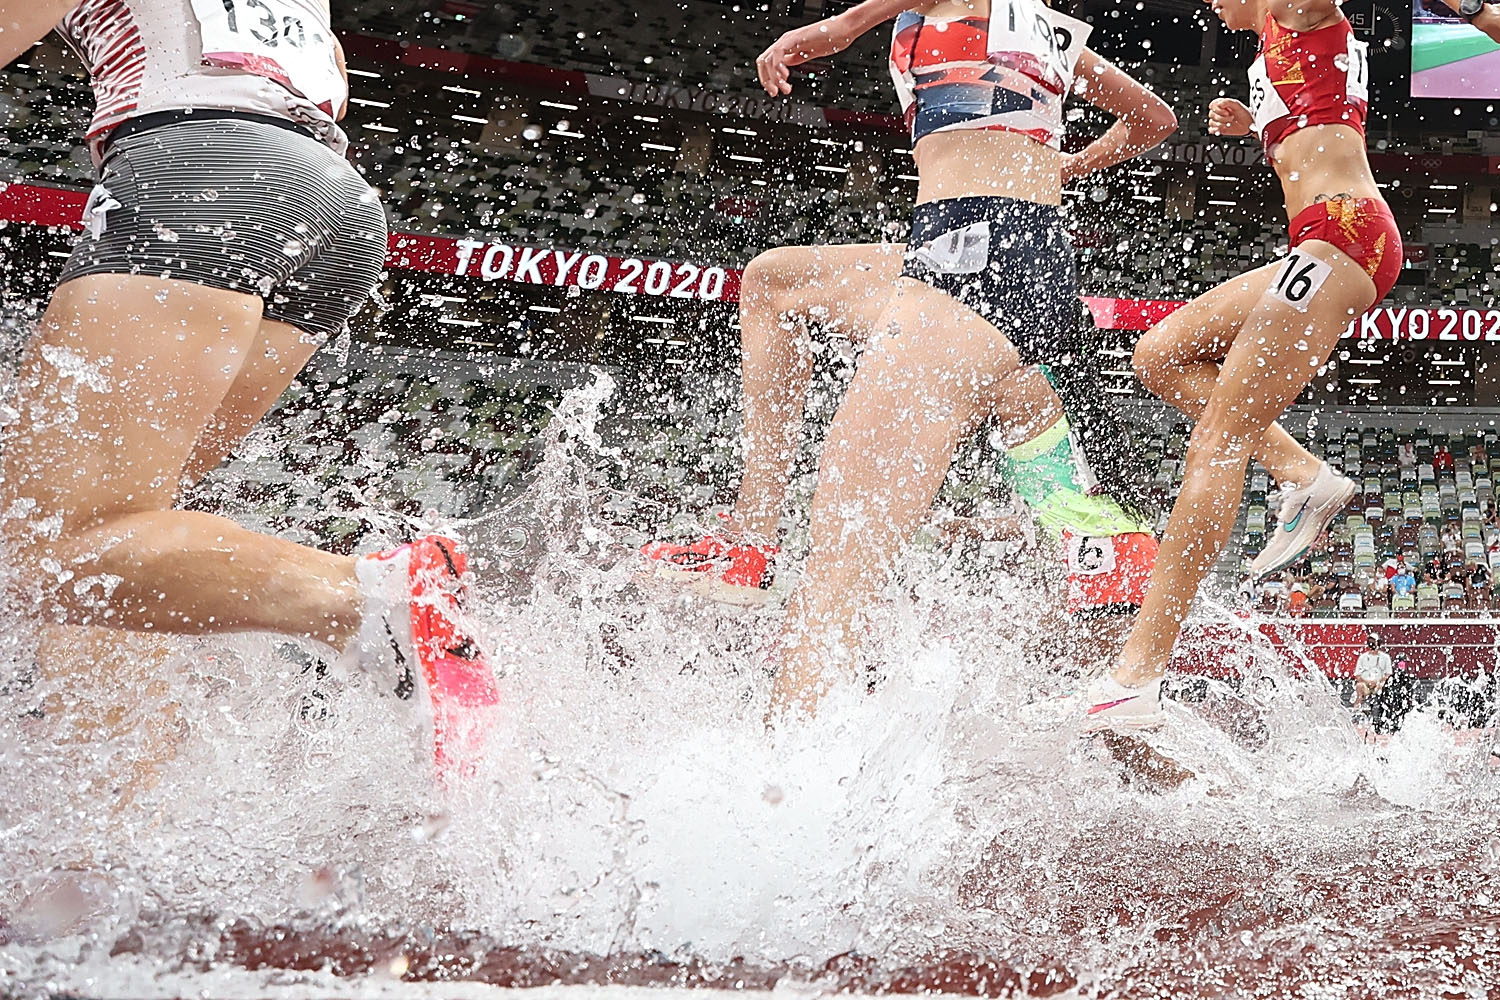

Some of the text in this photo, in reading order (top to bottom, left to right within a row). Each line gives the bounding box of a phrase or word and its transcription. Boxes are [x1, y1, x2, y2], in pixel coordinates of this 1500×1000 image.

[1170, 143, 1246, 166] TOKYO
[454, 239, 726, 301] TOKYO 2020
[1277, 253, 1318, 302] 16
[1341, 307, 1430, 341] KYO
